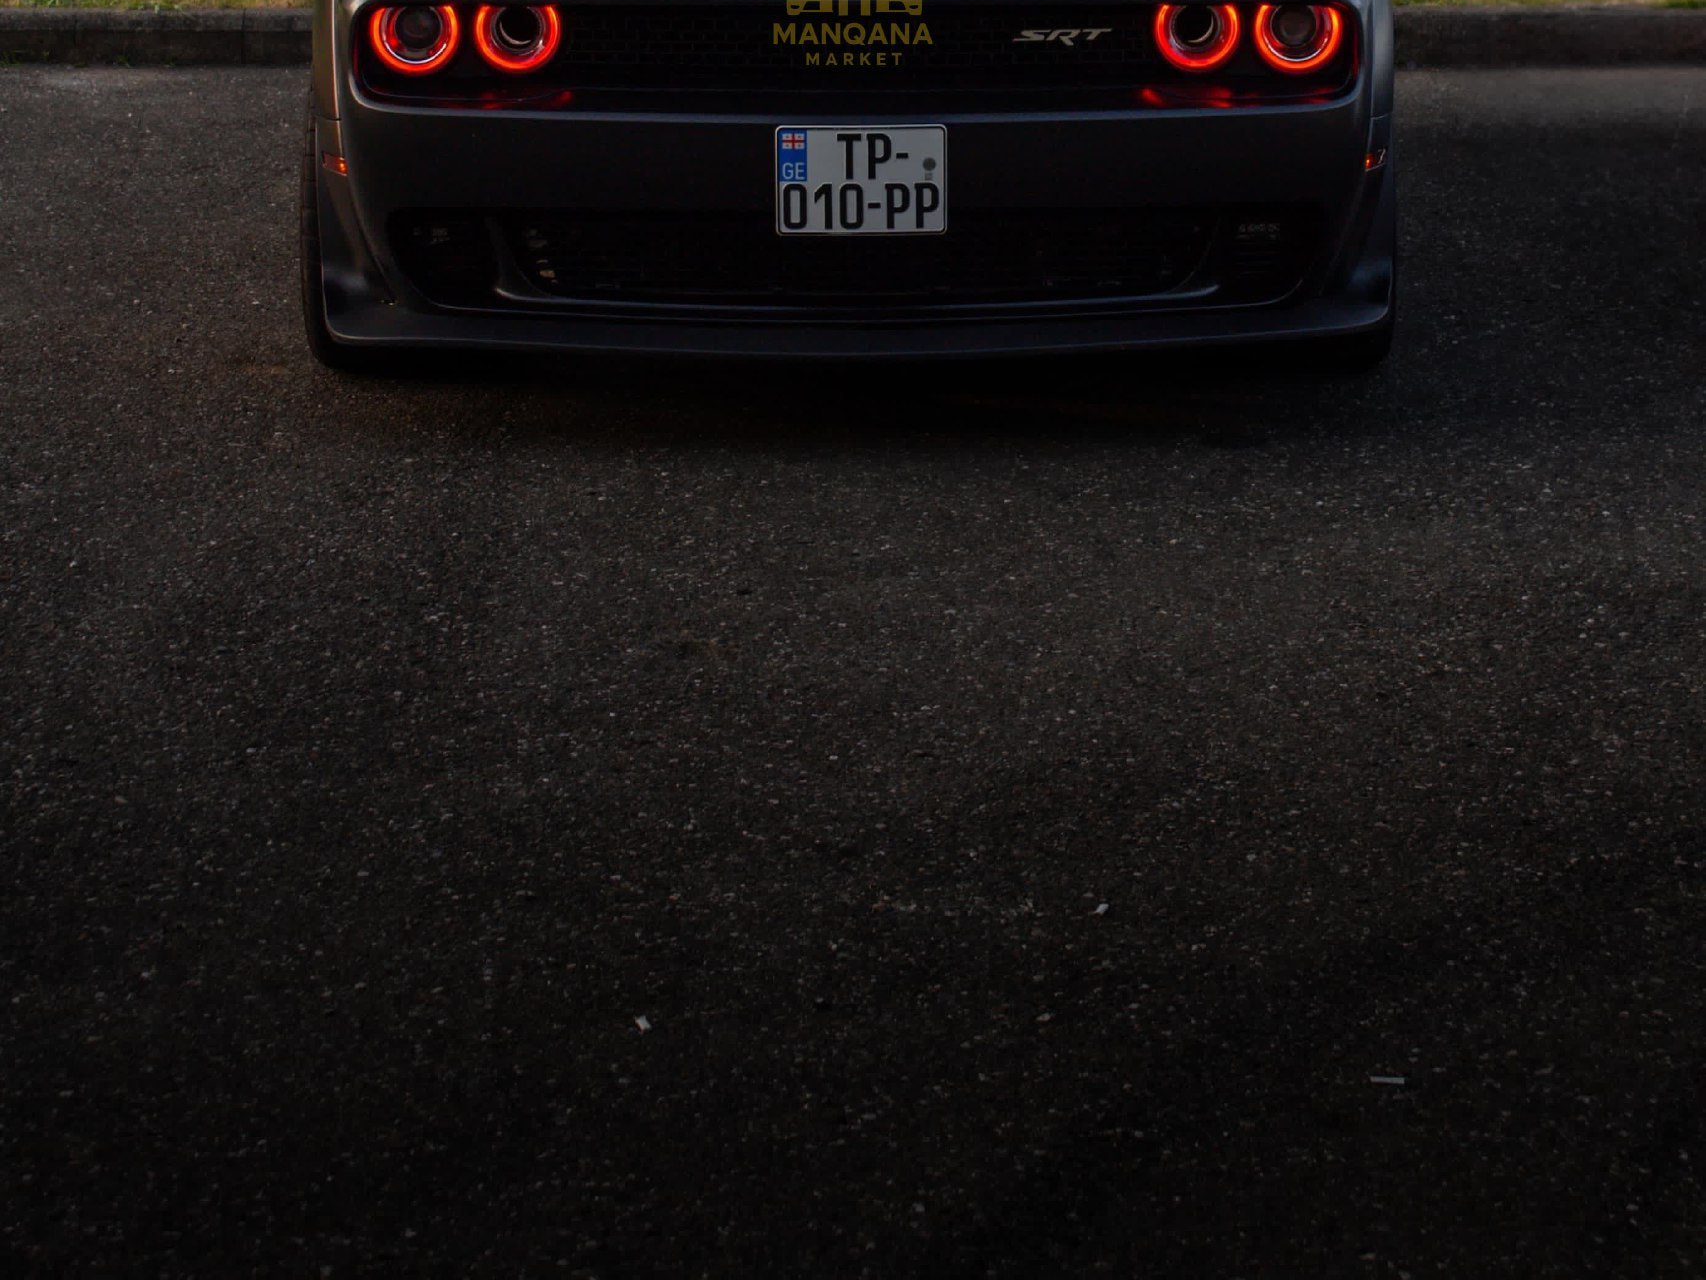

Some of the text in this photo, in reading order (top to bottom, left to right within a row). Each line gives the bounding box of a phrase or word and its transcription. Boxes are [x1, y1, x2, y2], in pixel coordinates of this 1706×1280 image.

[1012, 28, 1113, 46] SRT
[782, 162, 805, 180] GE
[783, 182, 940, 230] 010-PP
